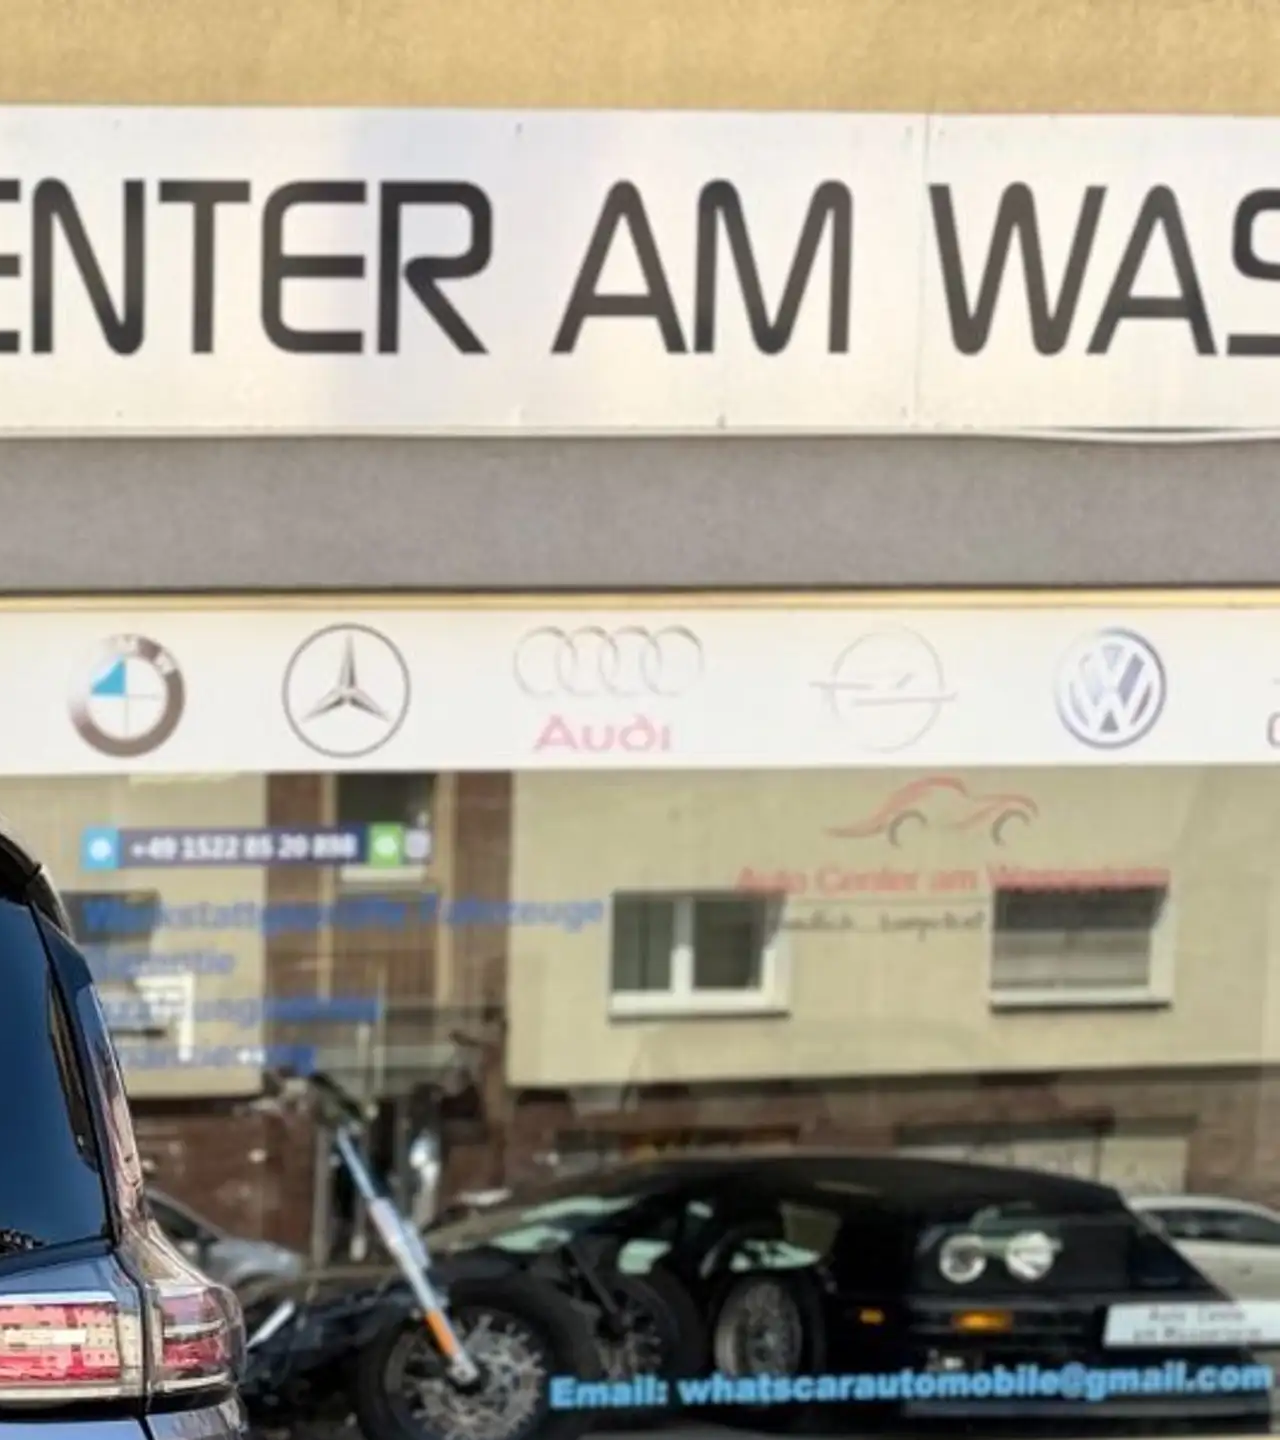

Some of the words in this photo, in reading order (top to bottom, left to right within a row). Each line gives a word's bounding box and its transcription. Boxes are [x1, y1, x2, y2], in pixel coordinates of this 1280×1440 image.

[550, 179, 853, 356] AM
[532, 714, 671, 753] Audi
[549, 1373, 669, 1410] Email:
[677, 1360, 1274, 1406] whatscarautomobile@gmail.com
